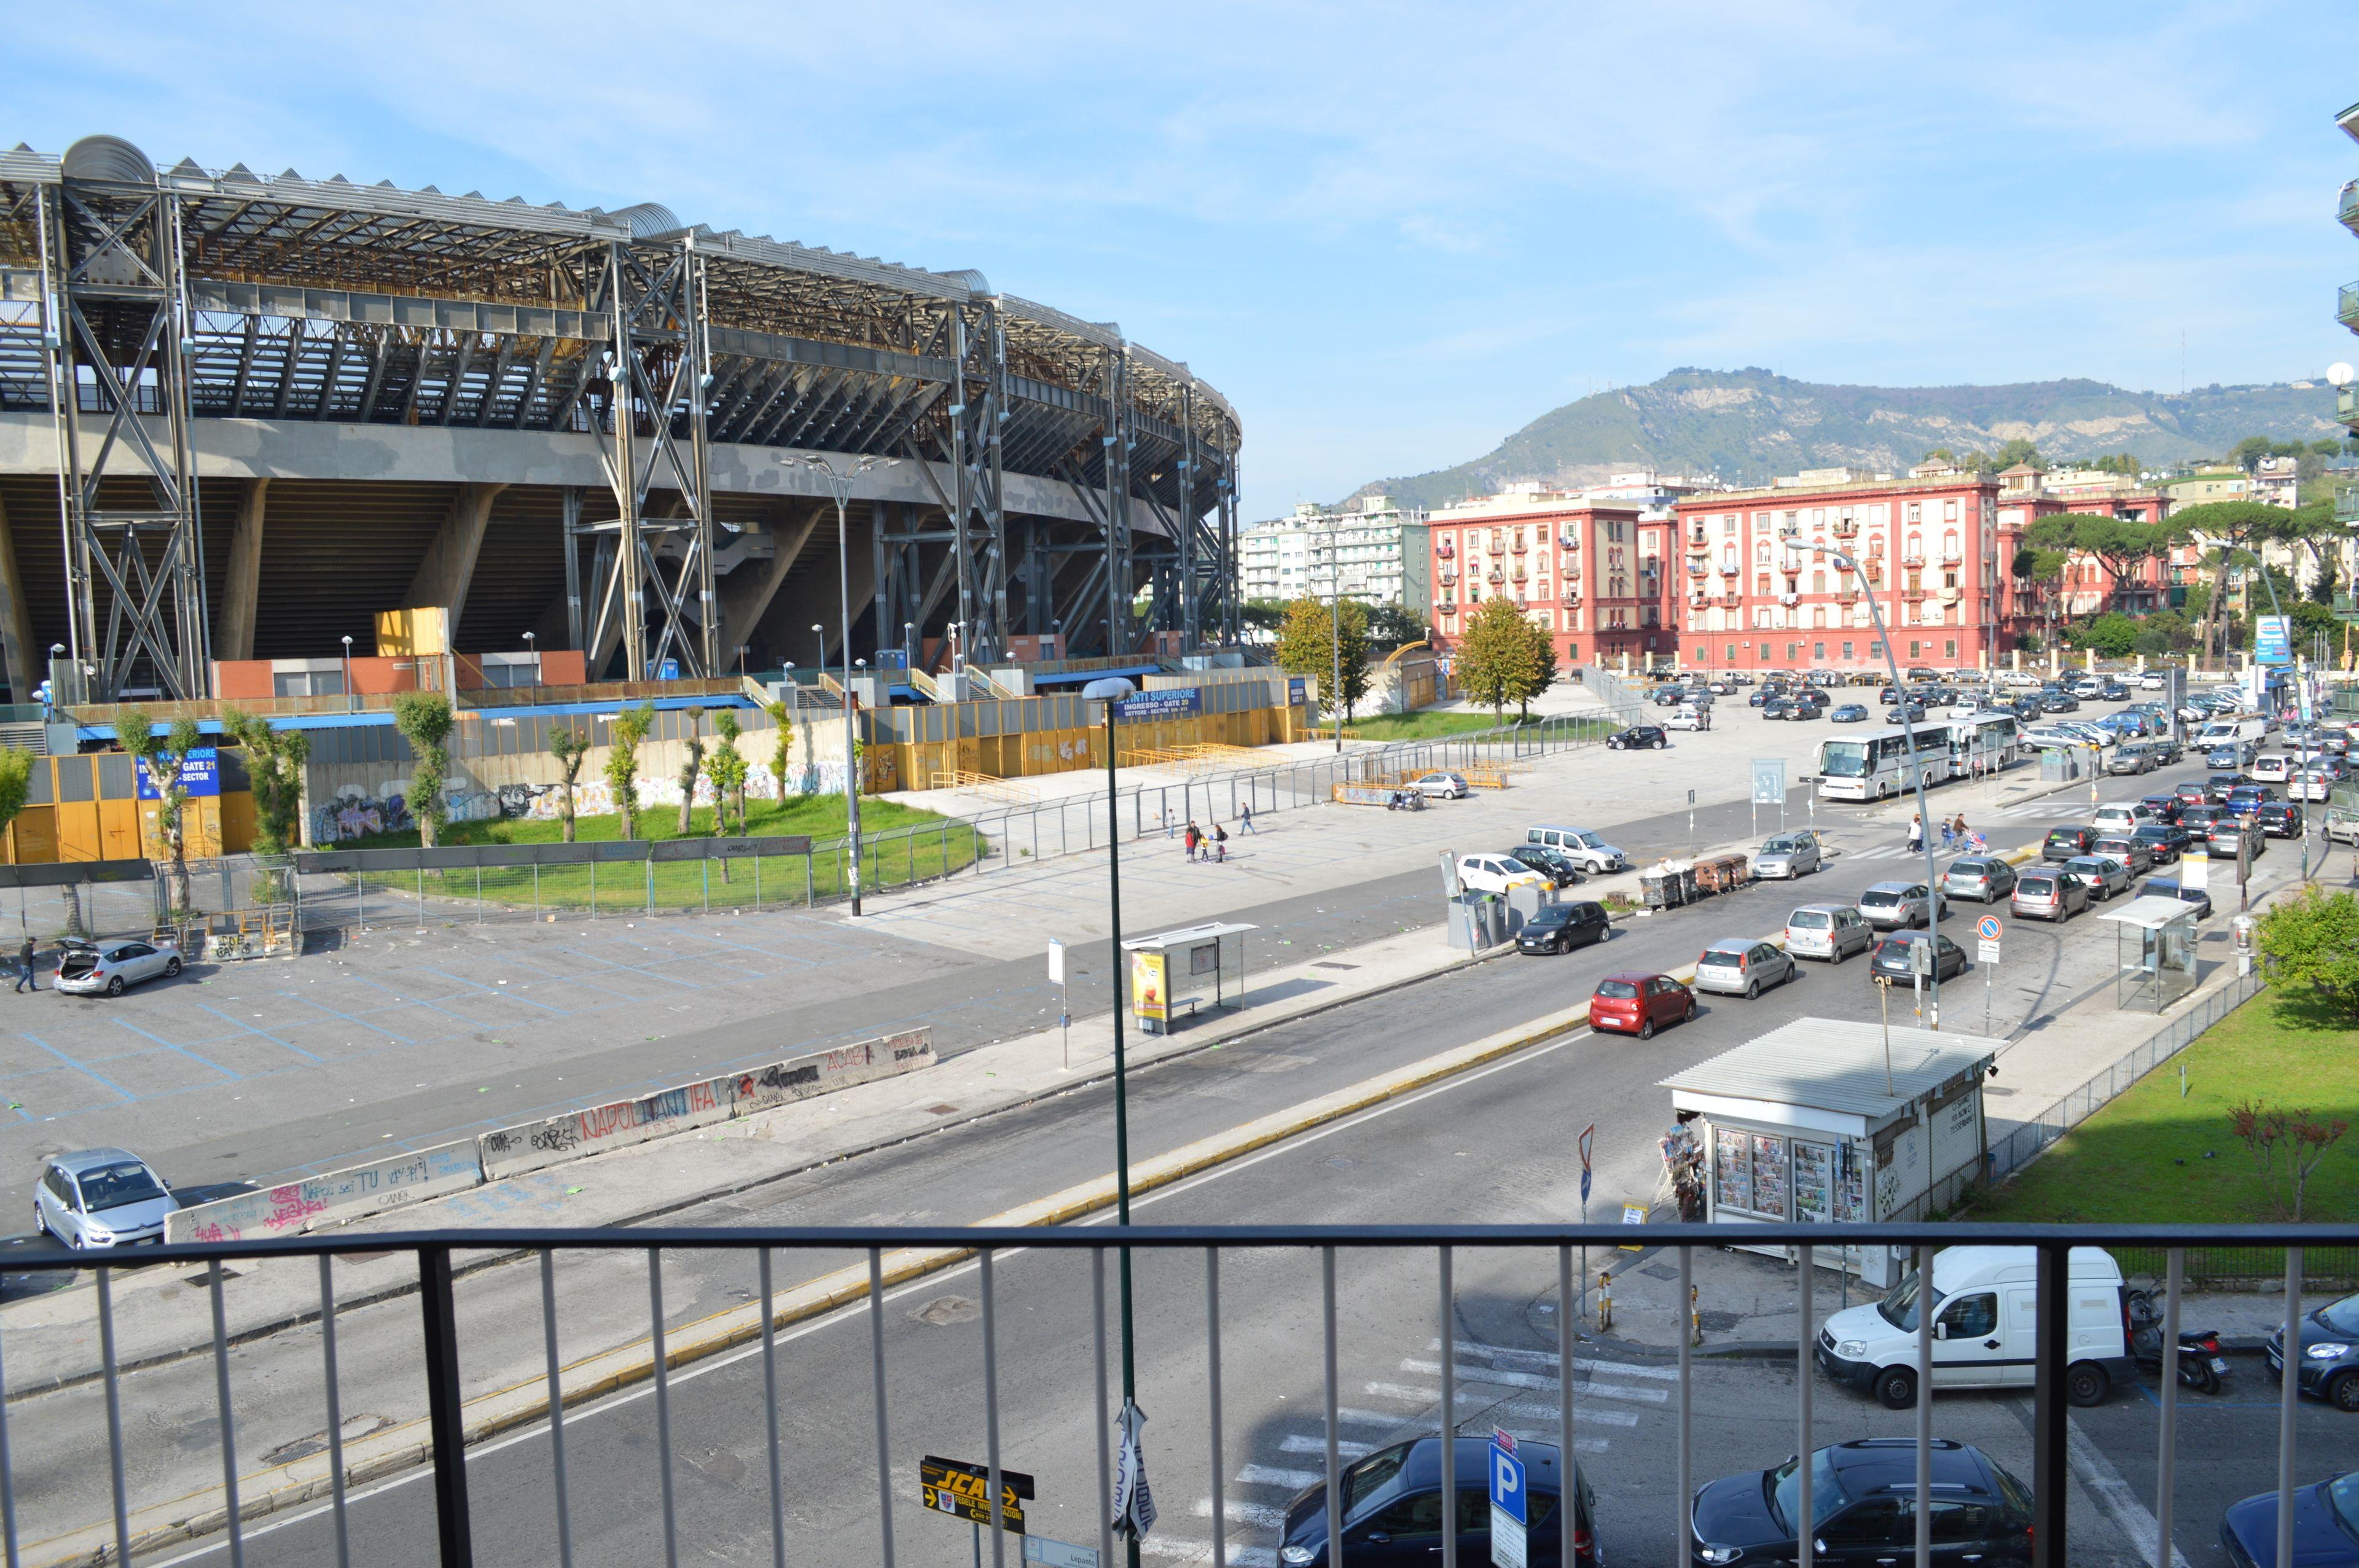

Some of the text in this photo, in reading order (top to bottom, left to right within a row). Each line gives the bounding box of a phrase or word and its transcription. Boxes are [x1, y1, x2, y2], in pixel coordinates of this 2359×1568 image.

[1151, 688, 1195, 701] SUPERIORE
[1124, 701, 1159, 711] INGRESSO
[182, 761, 215, 771] GATE 21
[182, 772, 209, 782] SECTOR
[354, 1170, 378, 1192] TU
[1499, 1432, 1511, 1446] 3801
[1496, 1454, 1518, 1504] P
[955, 1495, 1022, 1520] FEDELE INVEAZIONI
[1071, 1554, 1095, 1566] Lepanto
